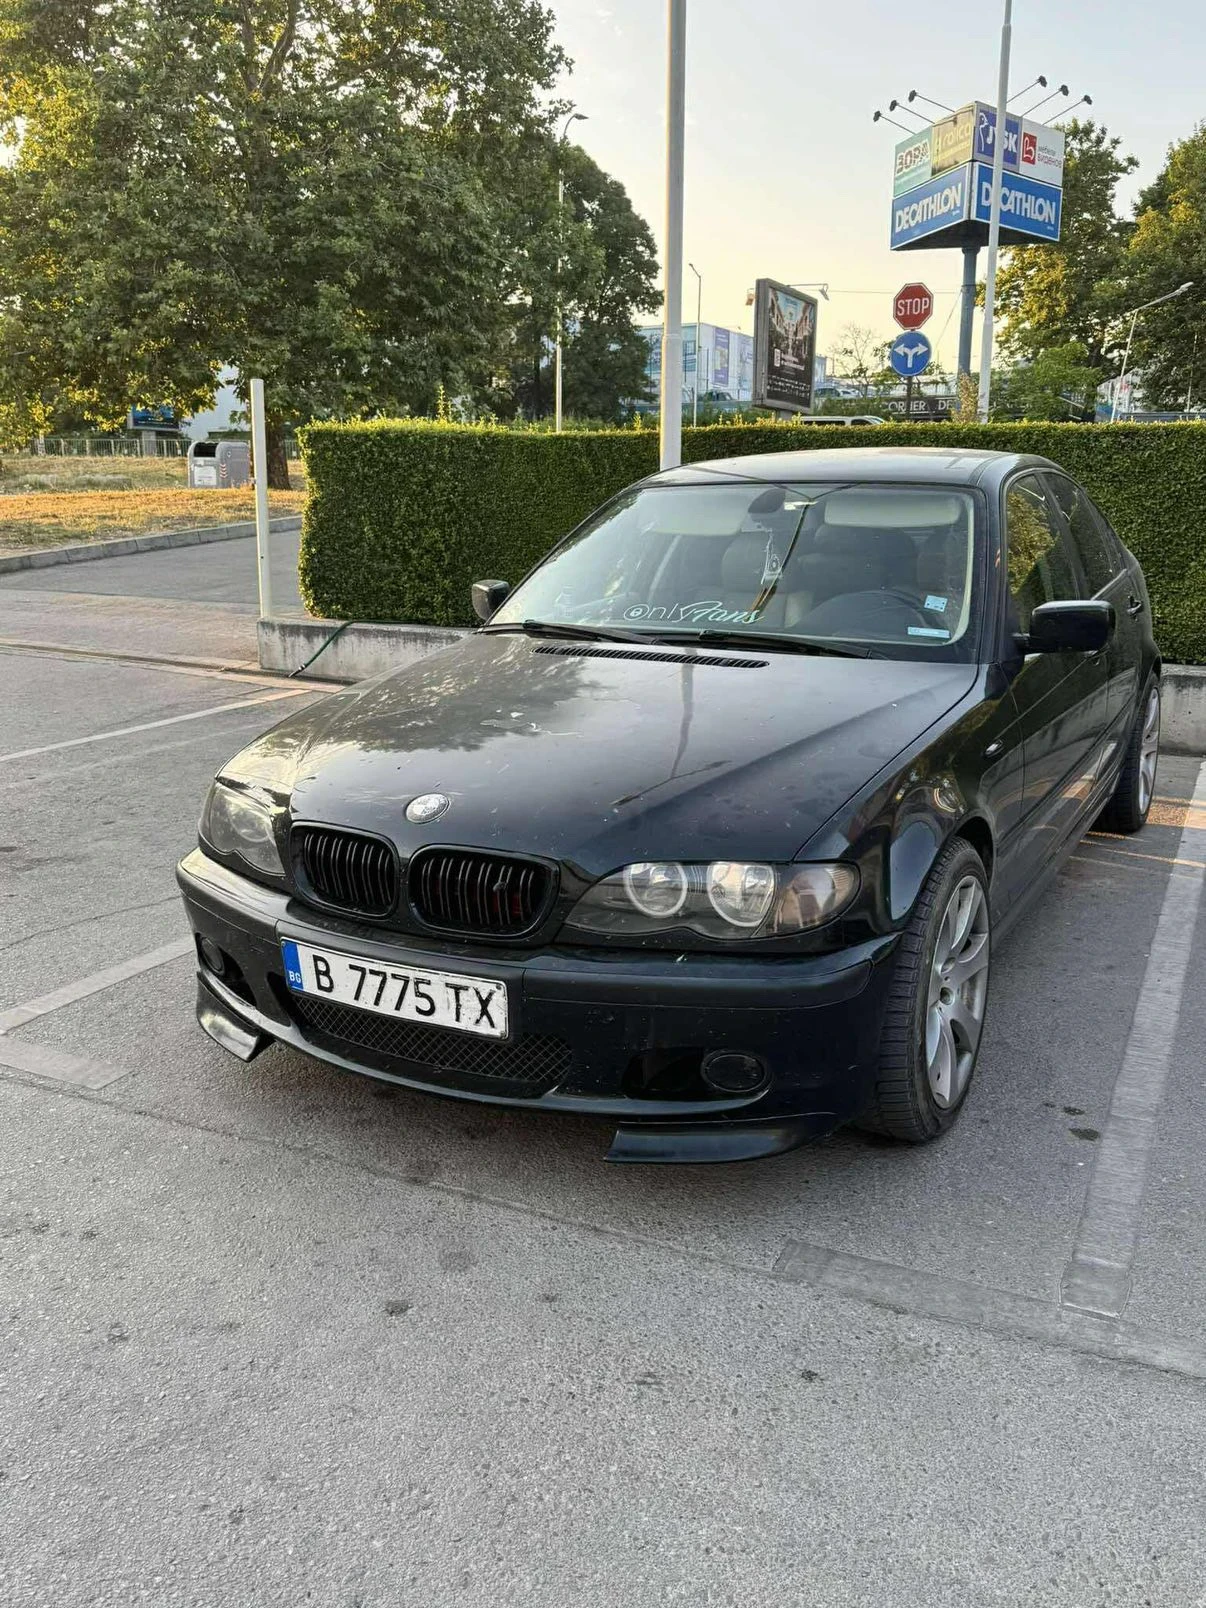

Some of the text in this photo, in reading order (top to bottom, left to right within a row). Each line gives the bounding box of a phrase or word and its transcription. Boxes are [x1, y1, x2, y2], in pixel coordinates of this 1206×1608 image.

[986, 125, 1018, 153] JSK
[895, 182, 962, 233] DECATHLON
[981, 181, 1056, 225] DCATHLON
[897, 297, 930, 316] STOP
[623, 600, 765, 624] OnlyFans
[289, 970, 302, 982] BG
[312, 954, 496, 1028] B 7775 TX
